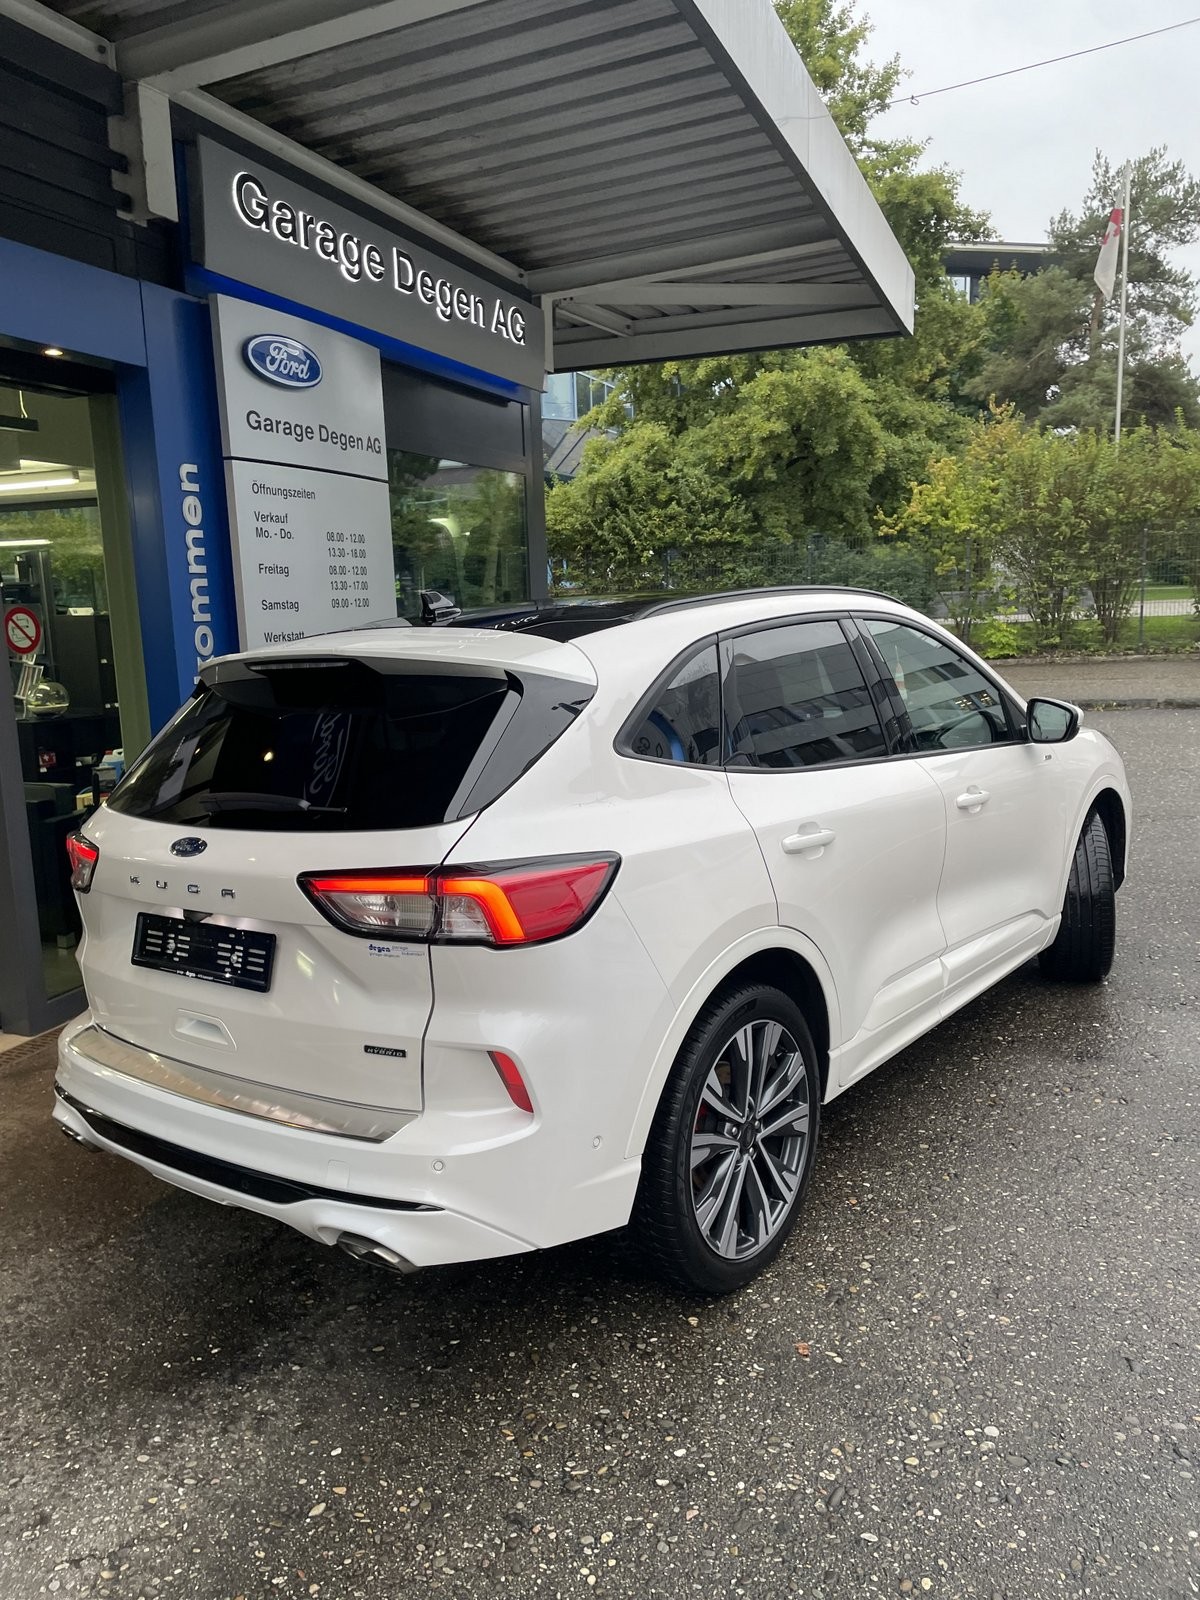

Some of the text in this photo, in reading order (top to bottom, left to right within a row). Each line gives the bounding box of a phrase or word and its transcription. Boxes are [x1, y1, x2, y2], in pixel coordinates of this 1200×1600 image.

[232, 171, 526, 345] Garage Degen AG
[266, 342, 310, 379] Ford
[246, 410, 382, 454] Garage Degen AG
[251, 480, 316, 500] Öffnungszeiten
[254, 511, 288, 524] Verkauf
[255, 527, 272, 539] Mo.
[279, 528, 294, 540] Do.
[327, 532, 344, 542] 08.00
[350, 534, 365, 544] 12.00
[328, 547, 345, 558] 13.30
[351, 549, 366, 558] 18.00
[258, 563, 290, 577] Freitag
[329, 565, 346, 575] 08.00
[352, 566, 367, 576] 12.00
[331, 581, 347, 590] 13.30
[353, 581, 368, 590] 17.00
[261, 599, 300, 612] Samstag
[331, 598, 349, 608] 09.00
[354, 598, 369, 608] 12.00
[367, 1047, 403, 1057] HYBRID
